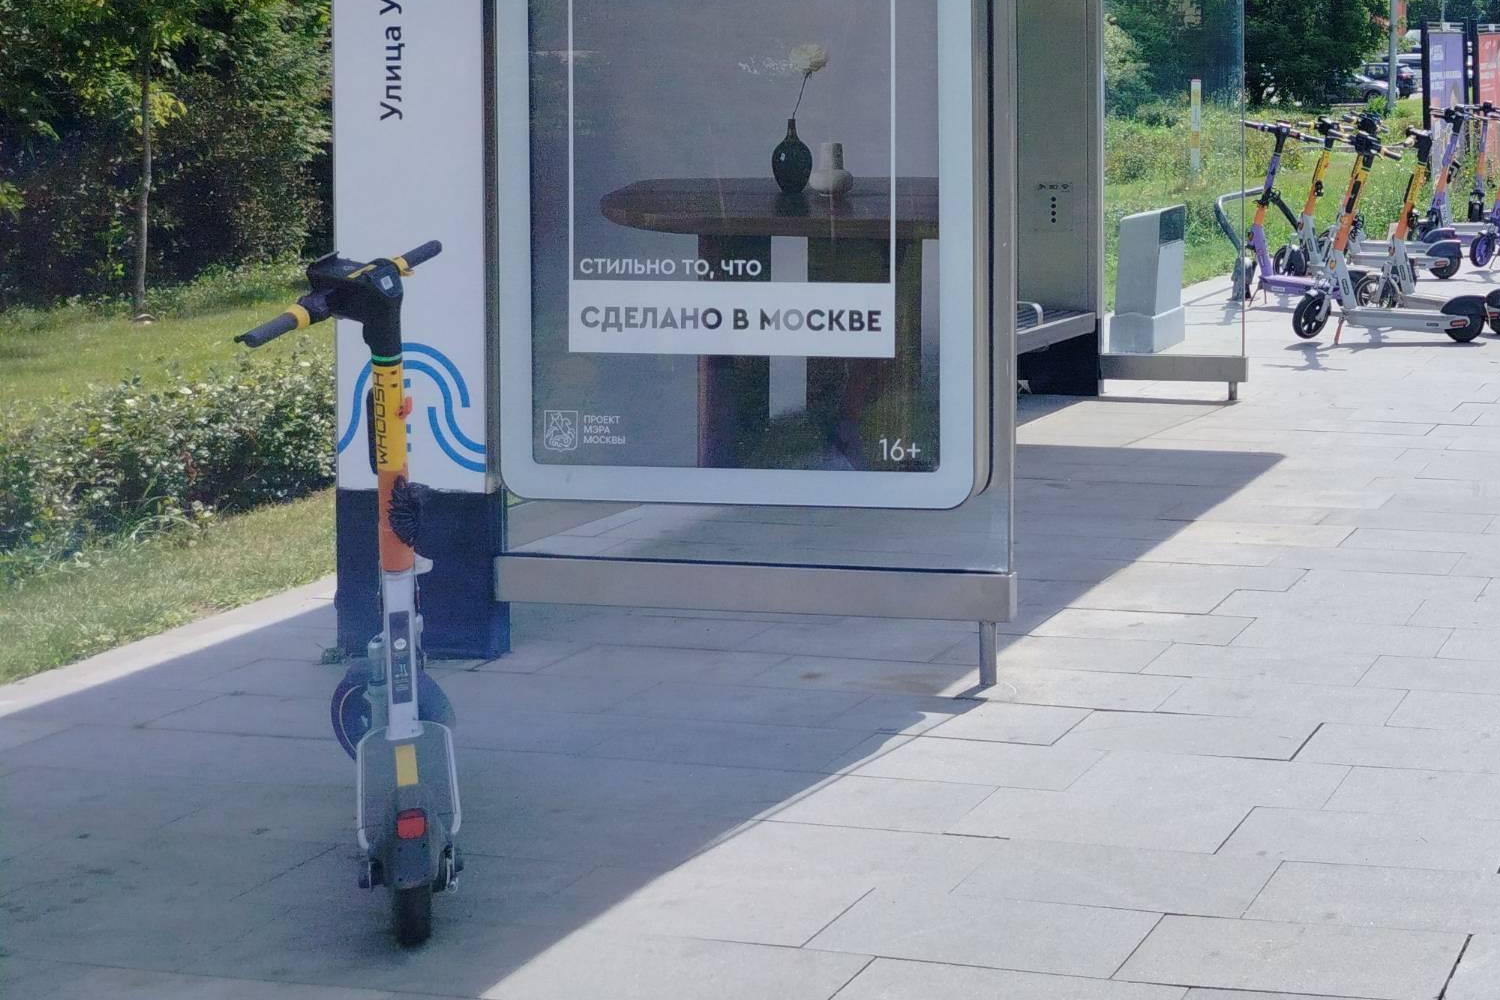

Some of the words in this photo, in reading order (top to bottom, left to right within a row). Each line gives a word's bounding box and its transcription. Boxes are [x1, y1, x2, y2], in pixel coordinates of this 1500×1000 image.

[379, 25, 406, 121] Улица
[579, 257, 676, 276] СТИЛЬНО
[682, 258, 715, 280] ТО,
[720, 258, 762, 277] ЧТО
[580, 305, 723, 334] СДЕЛАНО
[732, 308, 750, 330] В
[759, 308, 883, 332] МОСКВЕ
[373, 371, 389, 465] WHOOSH
[583, 415, 621, 424] ПРОЕКТ
[583, 425, 611, 434] МЭРА
[583, 435, 626, 445] МОСКВЫ
[878, 438, 921, 461] 16+
